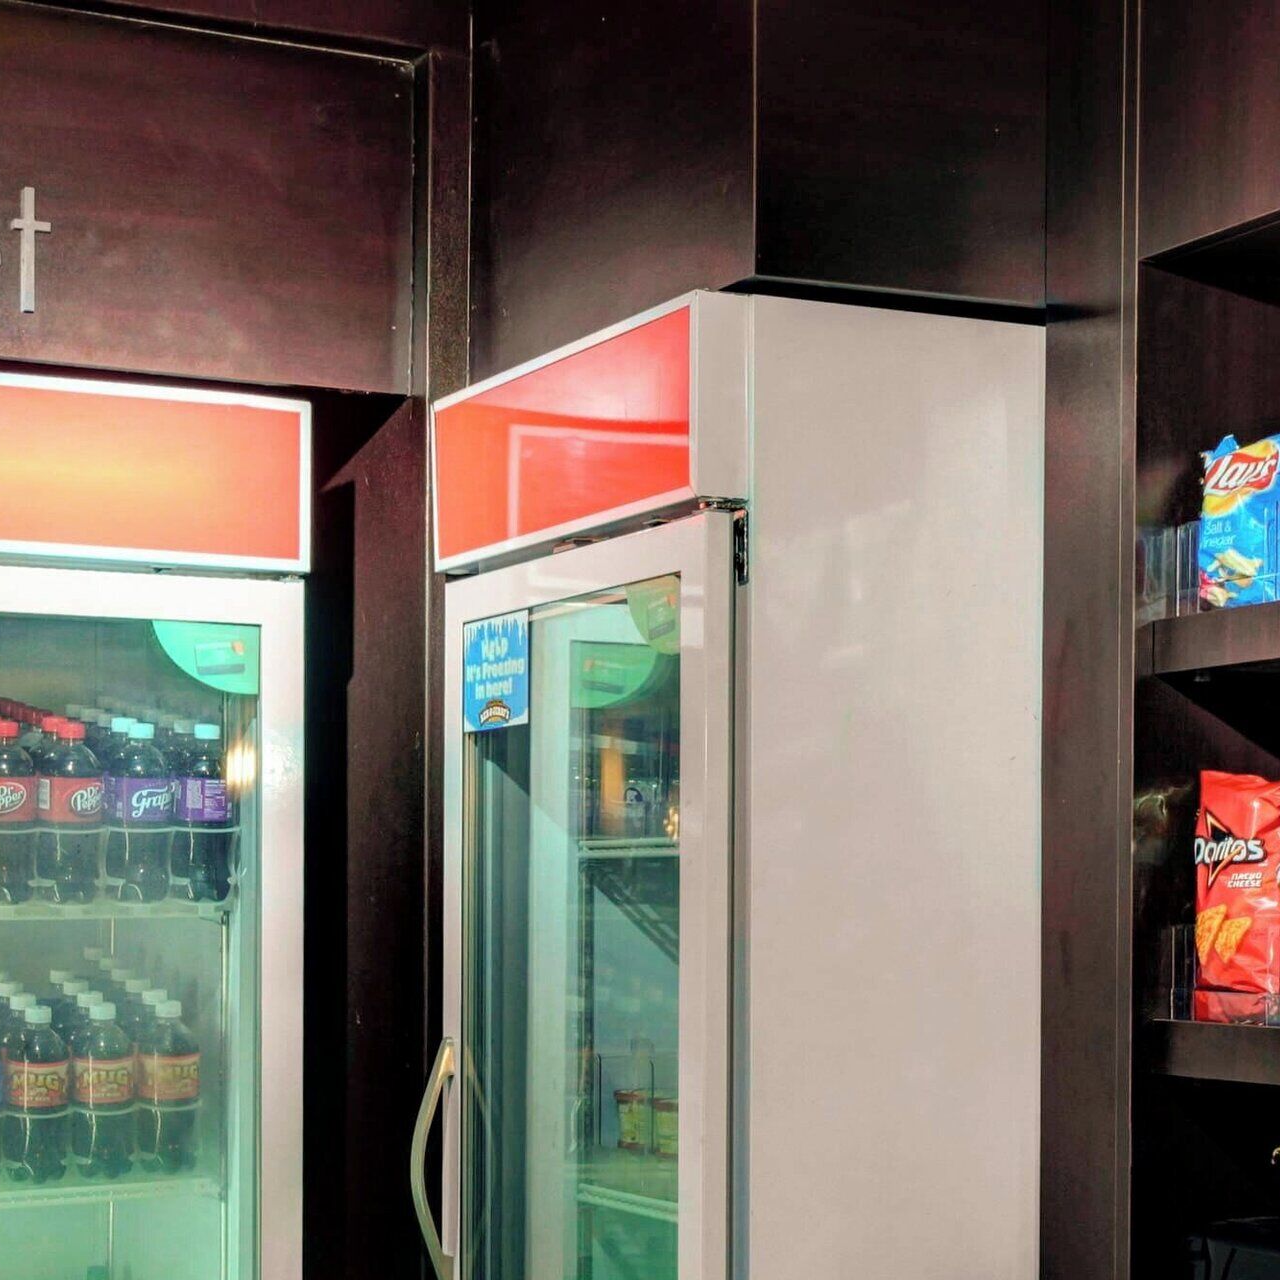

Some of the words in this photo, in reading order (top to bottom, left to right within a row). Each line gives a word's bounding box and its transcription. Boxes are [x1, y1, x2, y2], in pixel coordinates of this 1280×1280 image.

[1204, 454, 1277, 497] Lay's
[73, 789, 101, 812] Pepp
[132, 787, 170, 818] Grap
[1195, 836, 1265, 865] Doritos
[1227, 879, 1263, 888] CHEESE
[12, 1073, 60, 1090] MUG
[83, 1070, 129, 1088] MUG
